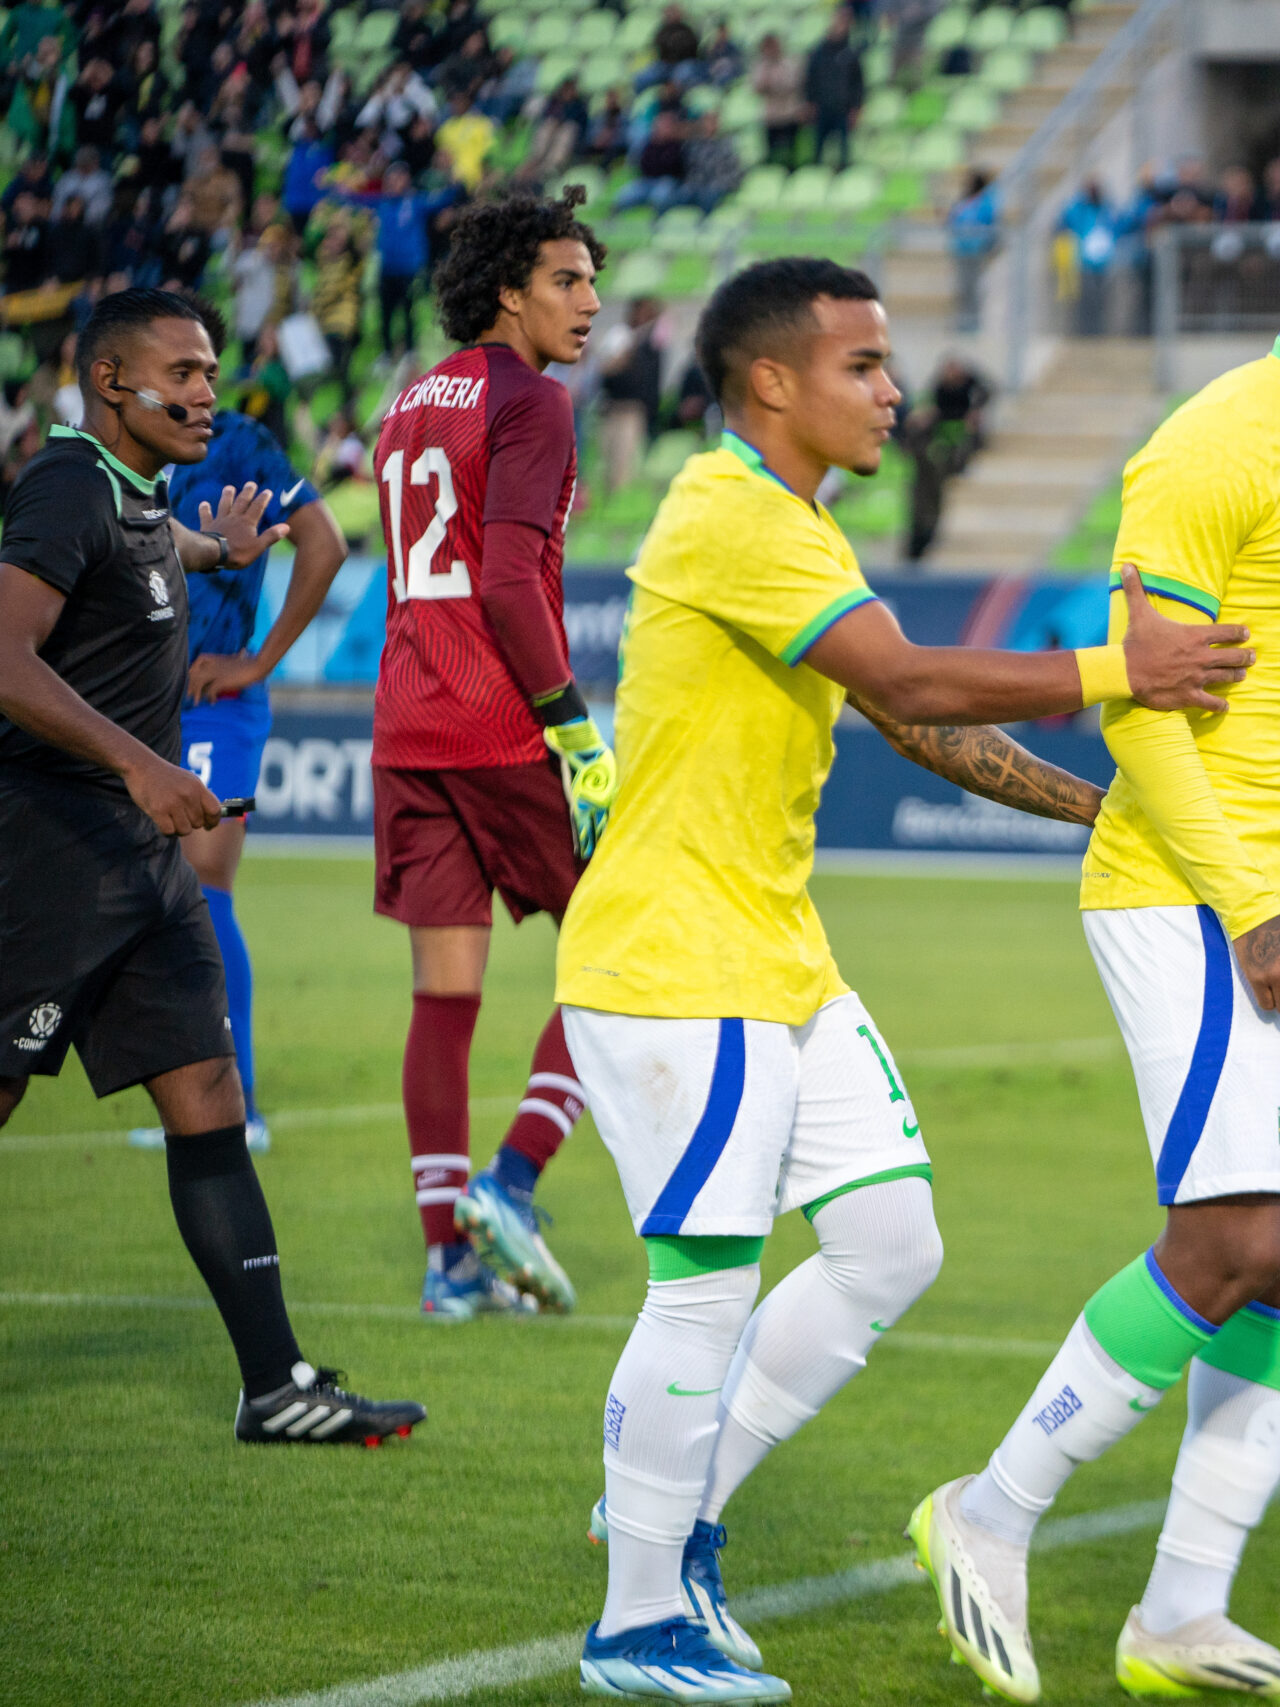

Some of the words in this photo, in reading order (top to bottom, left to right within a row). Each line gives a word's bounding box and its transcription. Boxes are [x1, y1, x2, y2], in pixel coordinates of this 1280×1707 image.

[400, 374, 485, 412] CARRERA
[382, 447, 472, 603] 12
[1032, 1384, 1083, 1436] BRASIL
